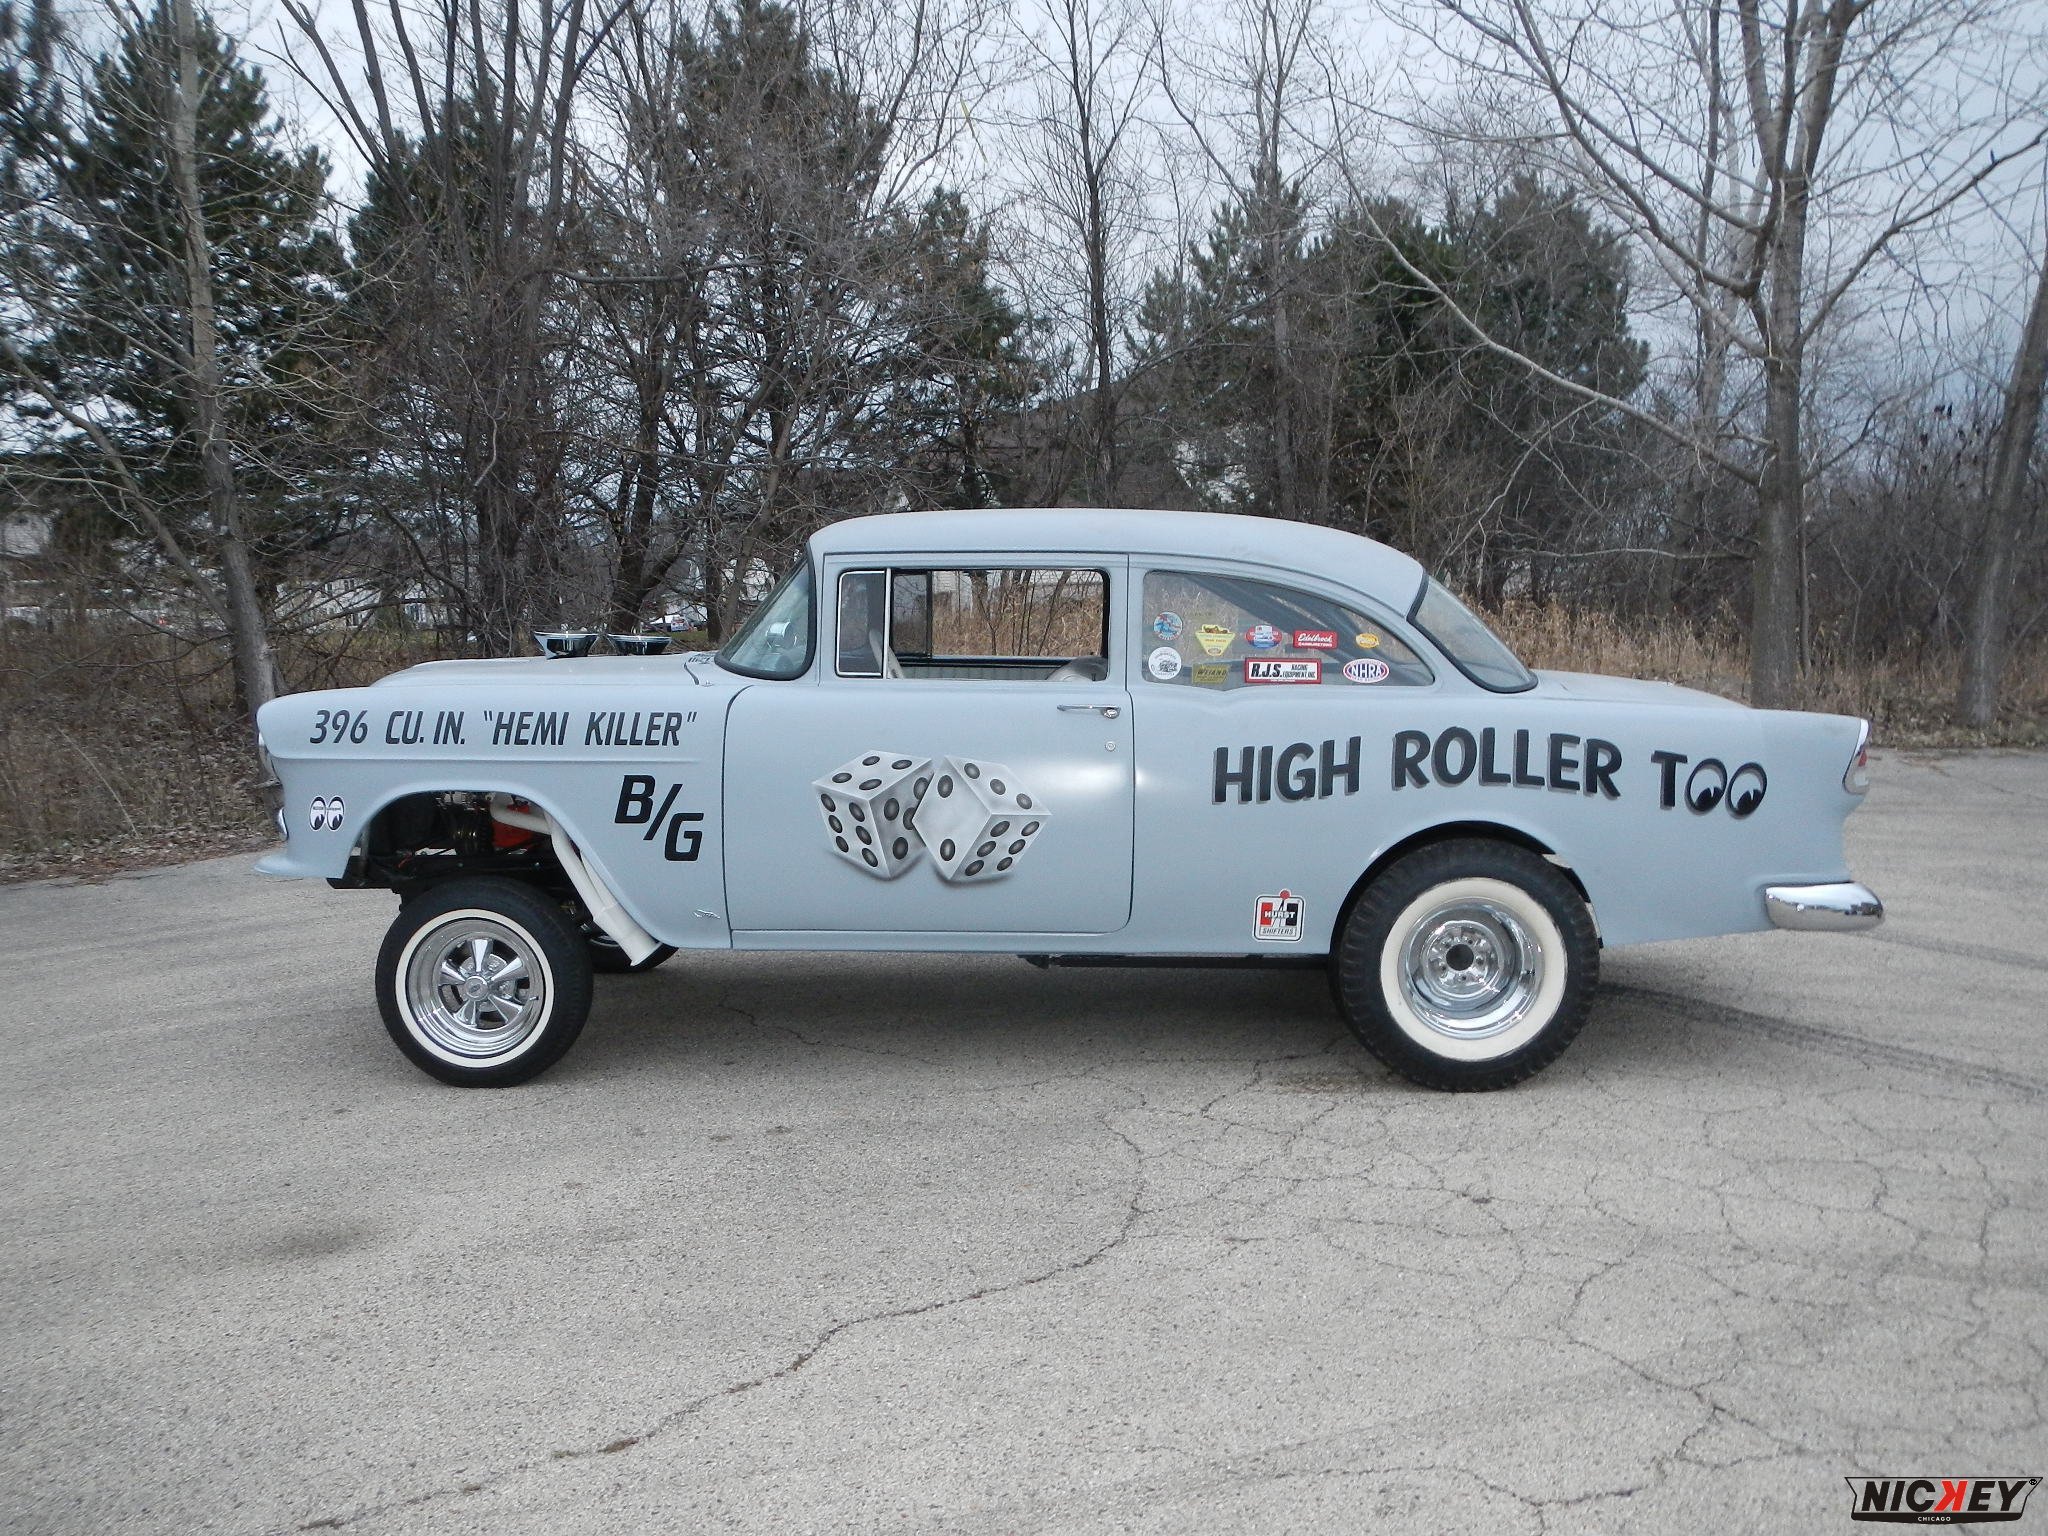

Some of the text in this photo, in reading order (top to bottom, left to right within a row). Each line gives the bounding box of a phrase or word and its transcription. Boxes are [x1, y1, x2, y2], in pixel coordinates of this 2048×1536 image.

[1250, 663, 1283, 678] R.J.S.
[1351, 663, 1382, 679] NHRA
[309, 709, 698, 746] 396 CU. IN. "HEMI KILLER"
[1212, 725, 1768, 819] HIGH ROLLER TOO
[614, 774, 705, 862] B/G
[1264, 910, 1296, 919] HURST
